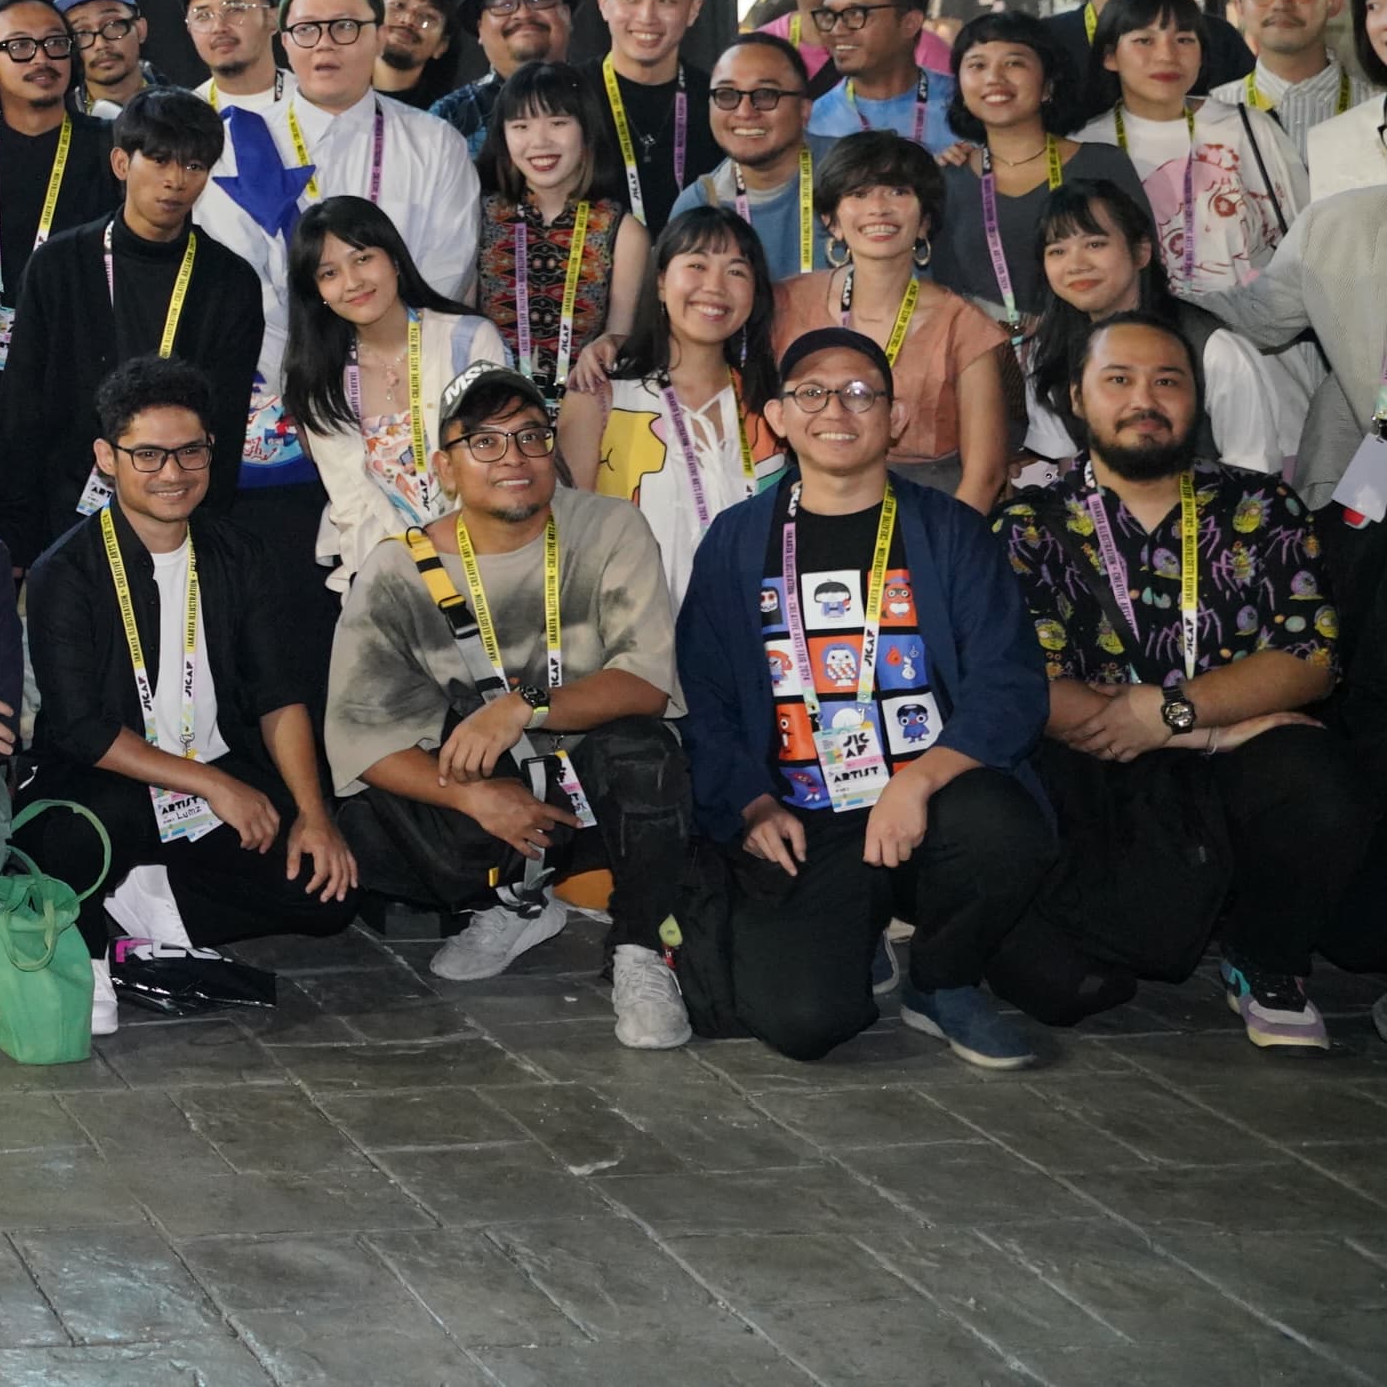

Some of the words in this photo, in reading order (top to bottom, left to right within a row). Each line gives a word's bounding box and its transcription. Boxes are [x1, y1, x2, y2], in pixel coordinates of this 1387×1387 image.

[409, 328, 418, 343] 2024
[562, 325, 571, 353] JICAF
[410, 344, 419, 356] FAIR
[410, 357, 419, 370] ARTS
[411, 371, 420, 399] CREATIVE
[412, 405, 423, 444] ILLUSTRATION
[415, 446, 425, 467] JAKARTA
[422, 479, 431, 511] JICAF
[699, 503, 708, 520] 2024
[1091, 500, 1105, 525] JAKARTA
[1184, 503, 1194, 529] CREATIVE
[105, 530, 115, 543] FAIR
[879, 516, 891, 542] CREATIVE
[107, 543, 119, 559] ARTS
[461, 544, 472, 558] ARTS
[787, 532, 795, 554] JAKARTA
[1097, 526, 1116, 567] ILLUSTRATION
[547, 544, 557, 569] CREATIVE
[1185, 536, 1195, 580] ILLUSTRATION
[112, 561, 126, 588] CREATIVE
[466, 562, 480, 588] CREATIVE
[787, 555, 796, 595] ILLUSTRATION
[871, 547, 886, 592] ILLUSTRATION
[547, 576, 557, 621] ILLUSTRATION
[1111, 572, 1126, 601] CREATIVE
[1186, 581, 1195, 603] JAKARTA
[188, 579, 198, 621] ILLUSTRATION
[868, 593, 879, 616] JAKARTA
[120, 594, 138, 635] ILLUSTRATION
[474, 592, 494, 639] ILLUSTRATION
[788, 602, 798, 630] CREATIVE
[187, 623, 196, 647] JAKARTA
[548, 622, 557, 644] JAKARTA
[793, 632, 802, 646] ARTS
[1186, 617, 1194, 654] JICAF
[128, 636, 141, 663] JAKARTA
[484, 640, 498, 662] JAKARTA
[795, 648, 806, 661] FAIR
[864, 629, 876, 667] JICAF
[185, 661, 195, 697] JICAF
[799, 663, 810, 680] 2024
[138, 675, 152, 711] JICAF
[843, 732, 870, 749] JIC
[845, 745, 867, 759] AF
[833, 766, 879, 783] ARTIST
[161, 795, 199, 814] ARTIST
